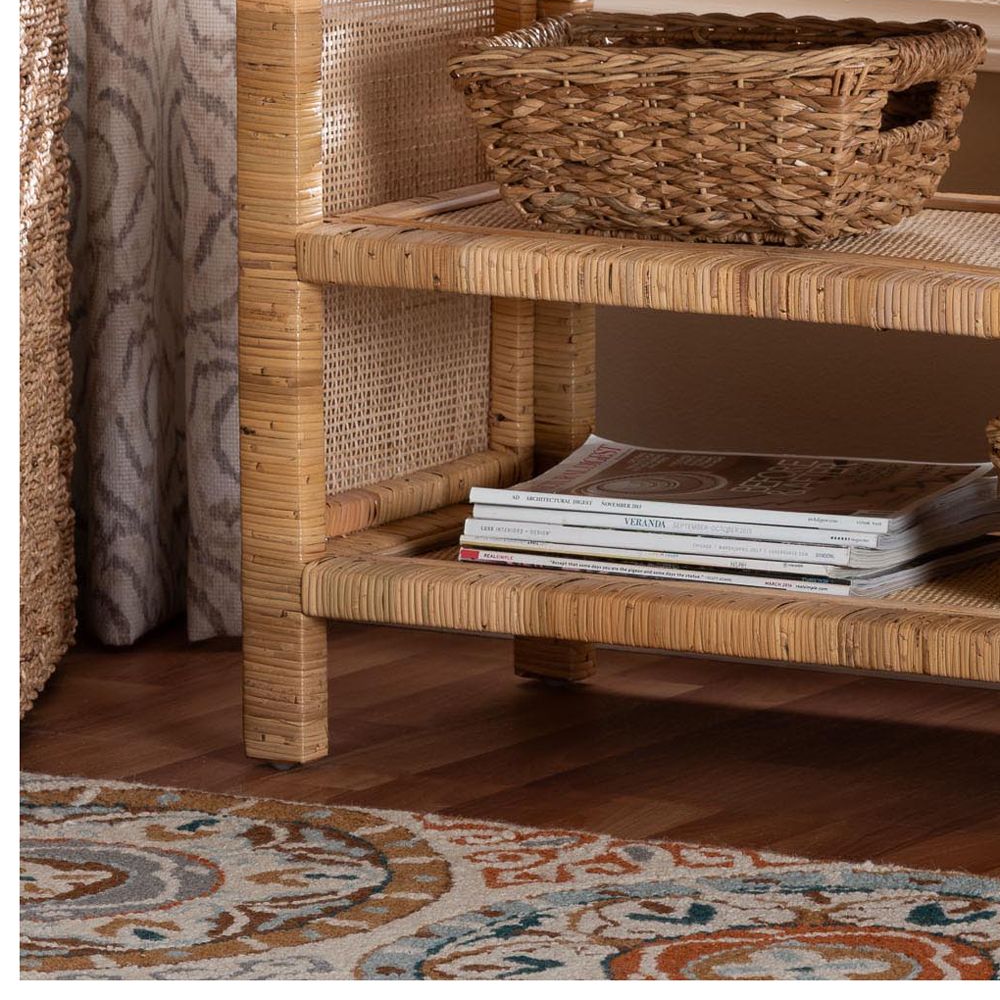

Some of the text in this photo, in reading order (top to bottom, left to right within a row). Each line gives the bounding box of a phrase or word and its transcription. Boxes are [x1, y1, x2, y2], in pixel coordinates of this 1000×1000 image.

[526, 496, 571, 505] ARCHITECTURAL
[601, 500, 631, 509] NOVEMBER
[624, 517, 666, 529] VERANDA
